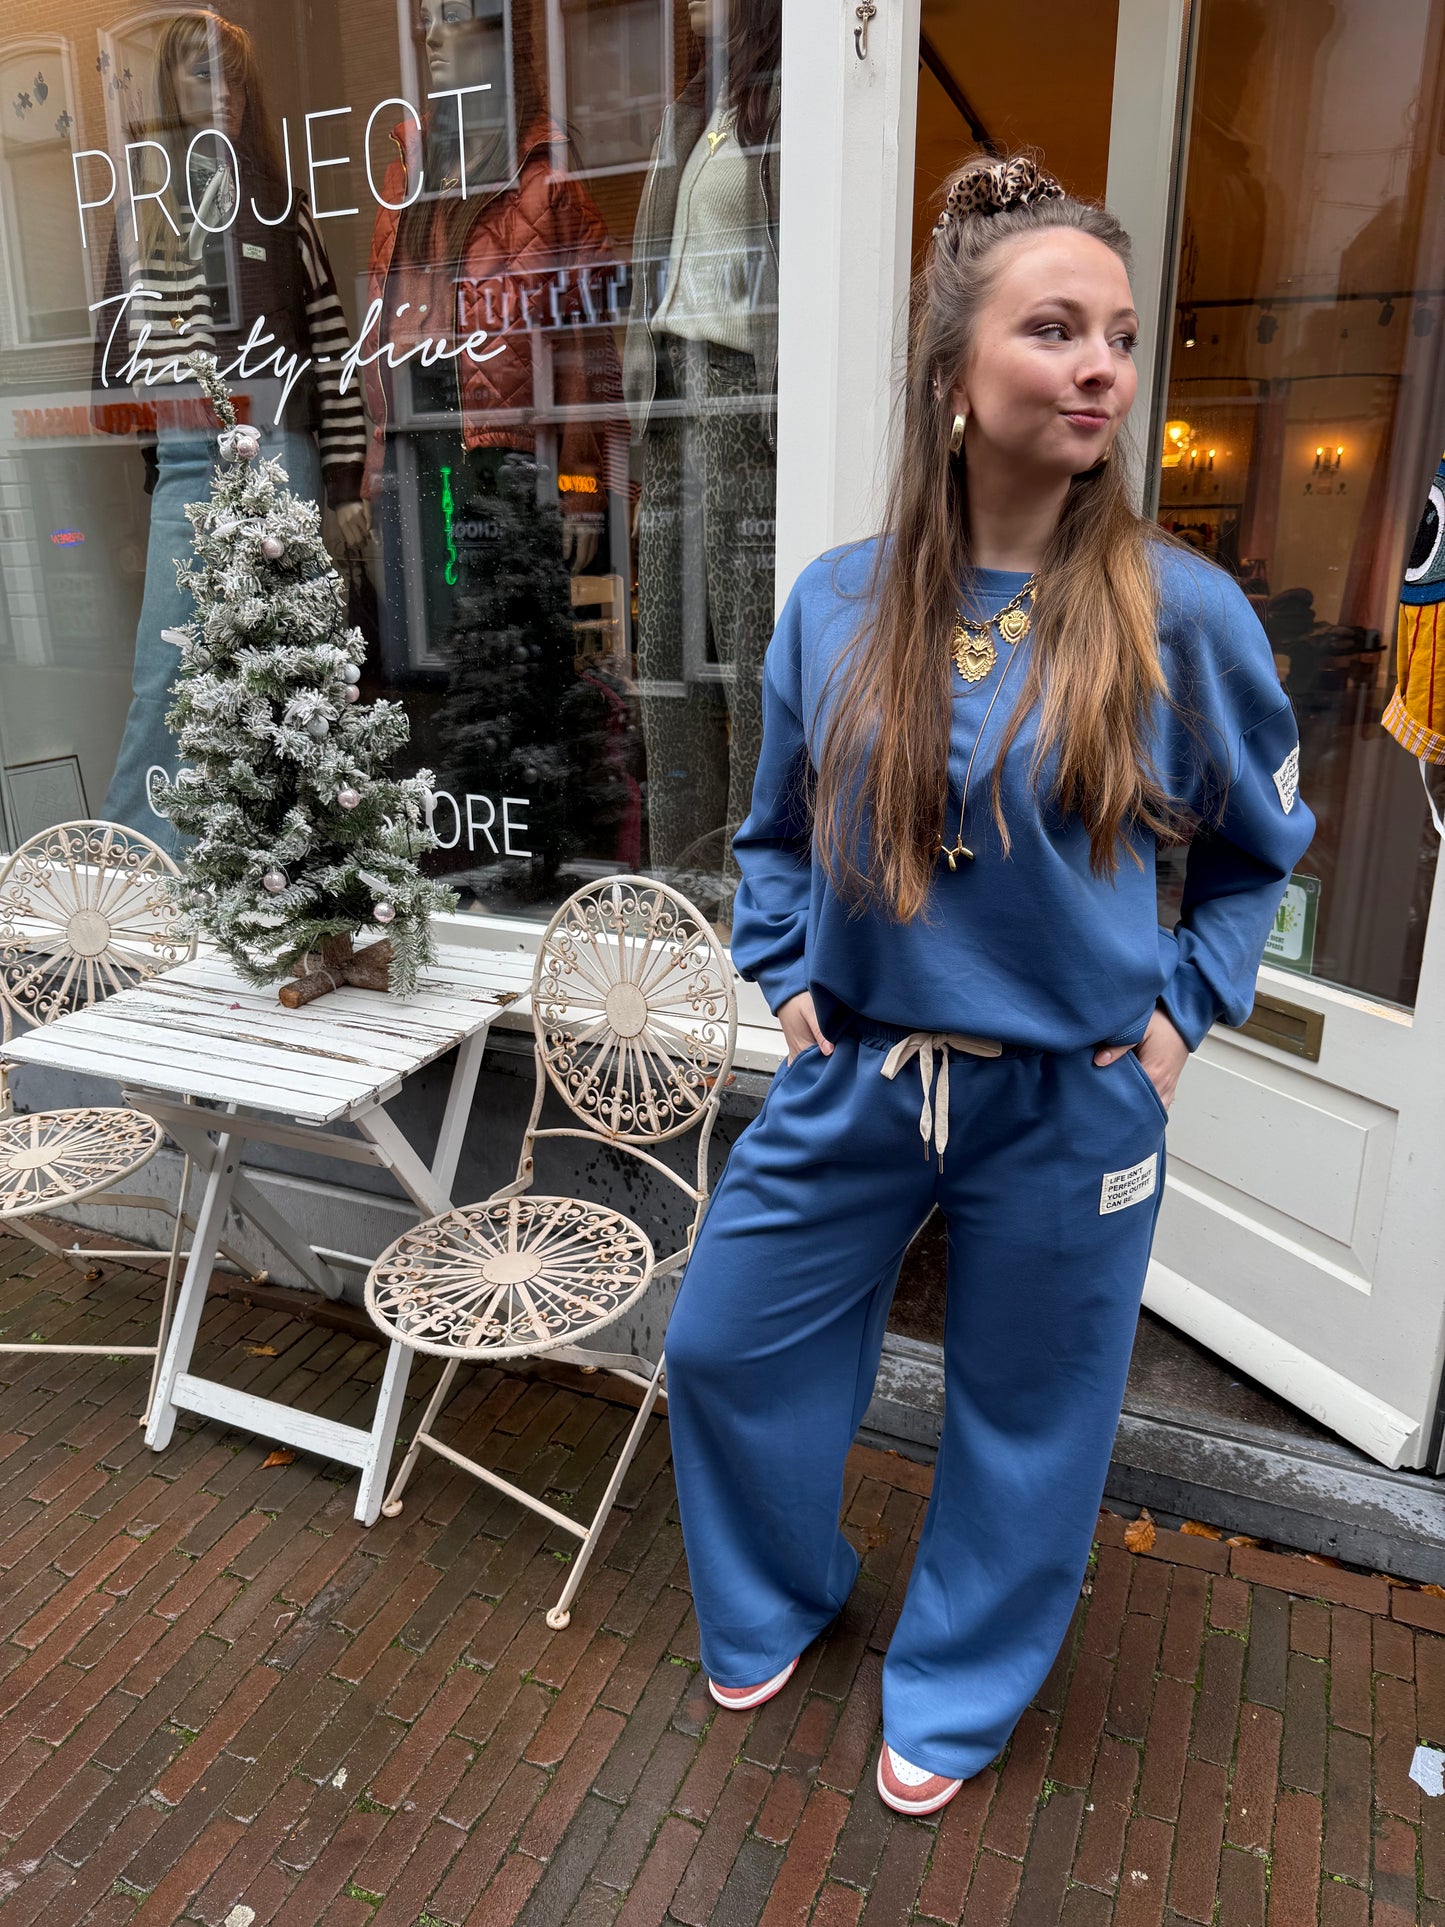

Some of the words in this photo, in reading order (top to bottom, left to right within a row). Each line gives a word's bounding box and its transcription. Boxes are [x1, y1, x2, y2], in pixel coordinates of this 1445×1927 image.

[72, 84, 492, 249] PROJECT
[382, 790, 533, 858] ORE
[1108, 1176, 1140, 1192] PERFECT
[1141, 1169, 1152, 1181] BUT
[1110, 1174, 1126, 1184] LIFE
[1127, 1166, 1143, 1180] ISN'T
[1107, 1190, 1128, 1201] YOUR
[1129, 1178, 1150, 1194] OUTFIT
[1106, 1200, 1122, 1209] CAN
